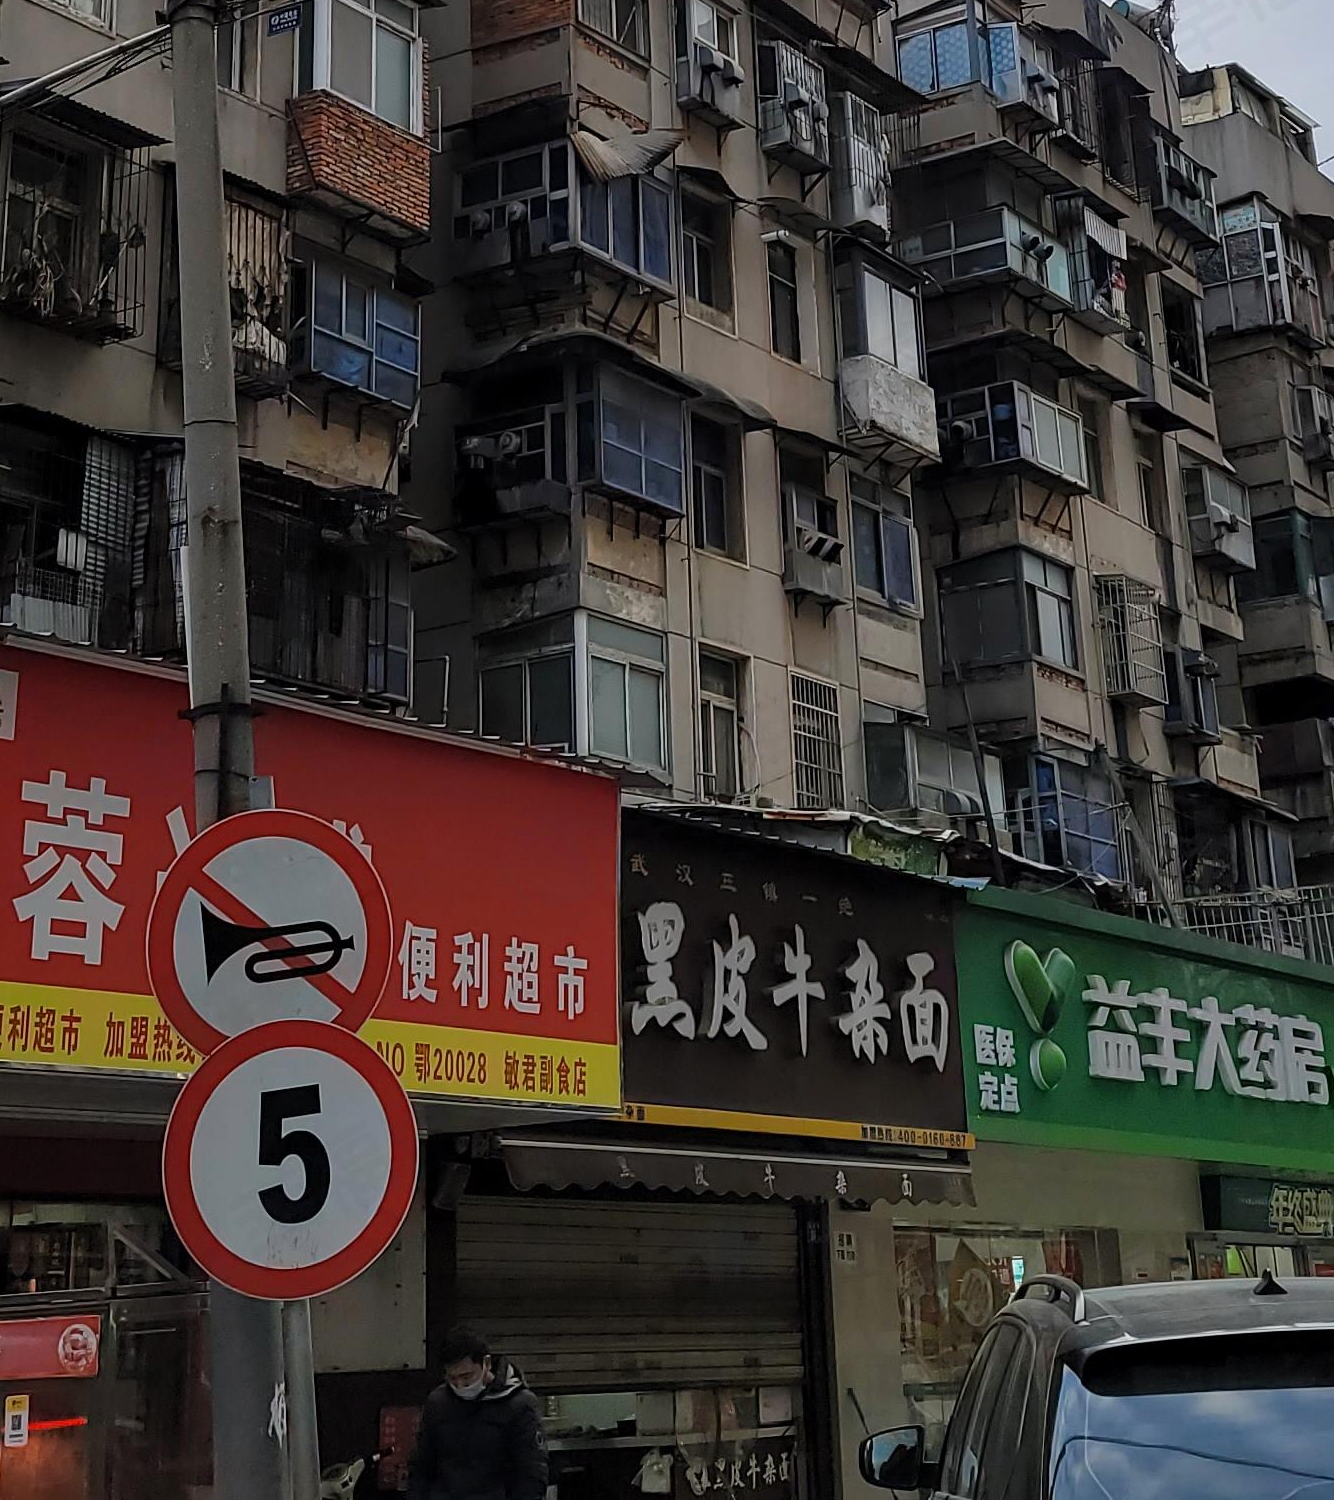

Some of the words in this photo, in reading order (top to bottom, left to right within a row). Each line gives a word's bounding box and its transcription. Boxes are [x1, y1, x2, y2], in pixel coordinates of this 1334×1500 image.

[398, 920, 589, 1021] 便利超市
[413, 1043, 487, 1084] 鄂20028
[504, 1050, 608, 1097] 敏君副食店
[974, 1023, 1016, 1067] 医保
[1082, 973, 1330, 1106] 益丰大药房
[979, 1071, 1022, 1114] 定点
[257, 1083, 331, 1224] 5
